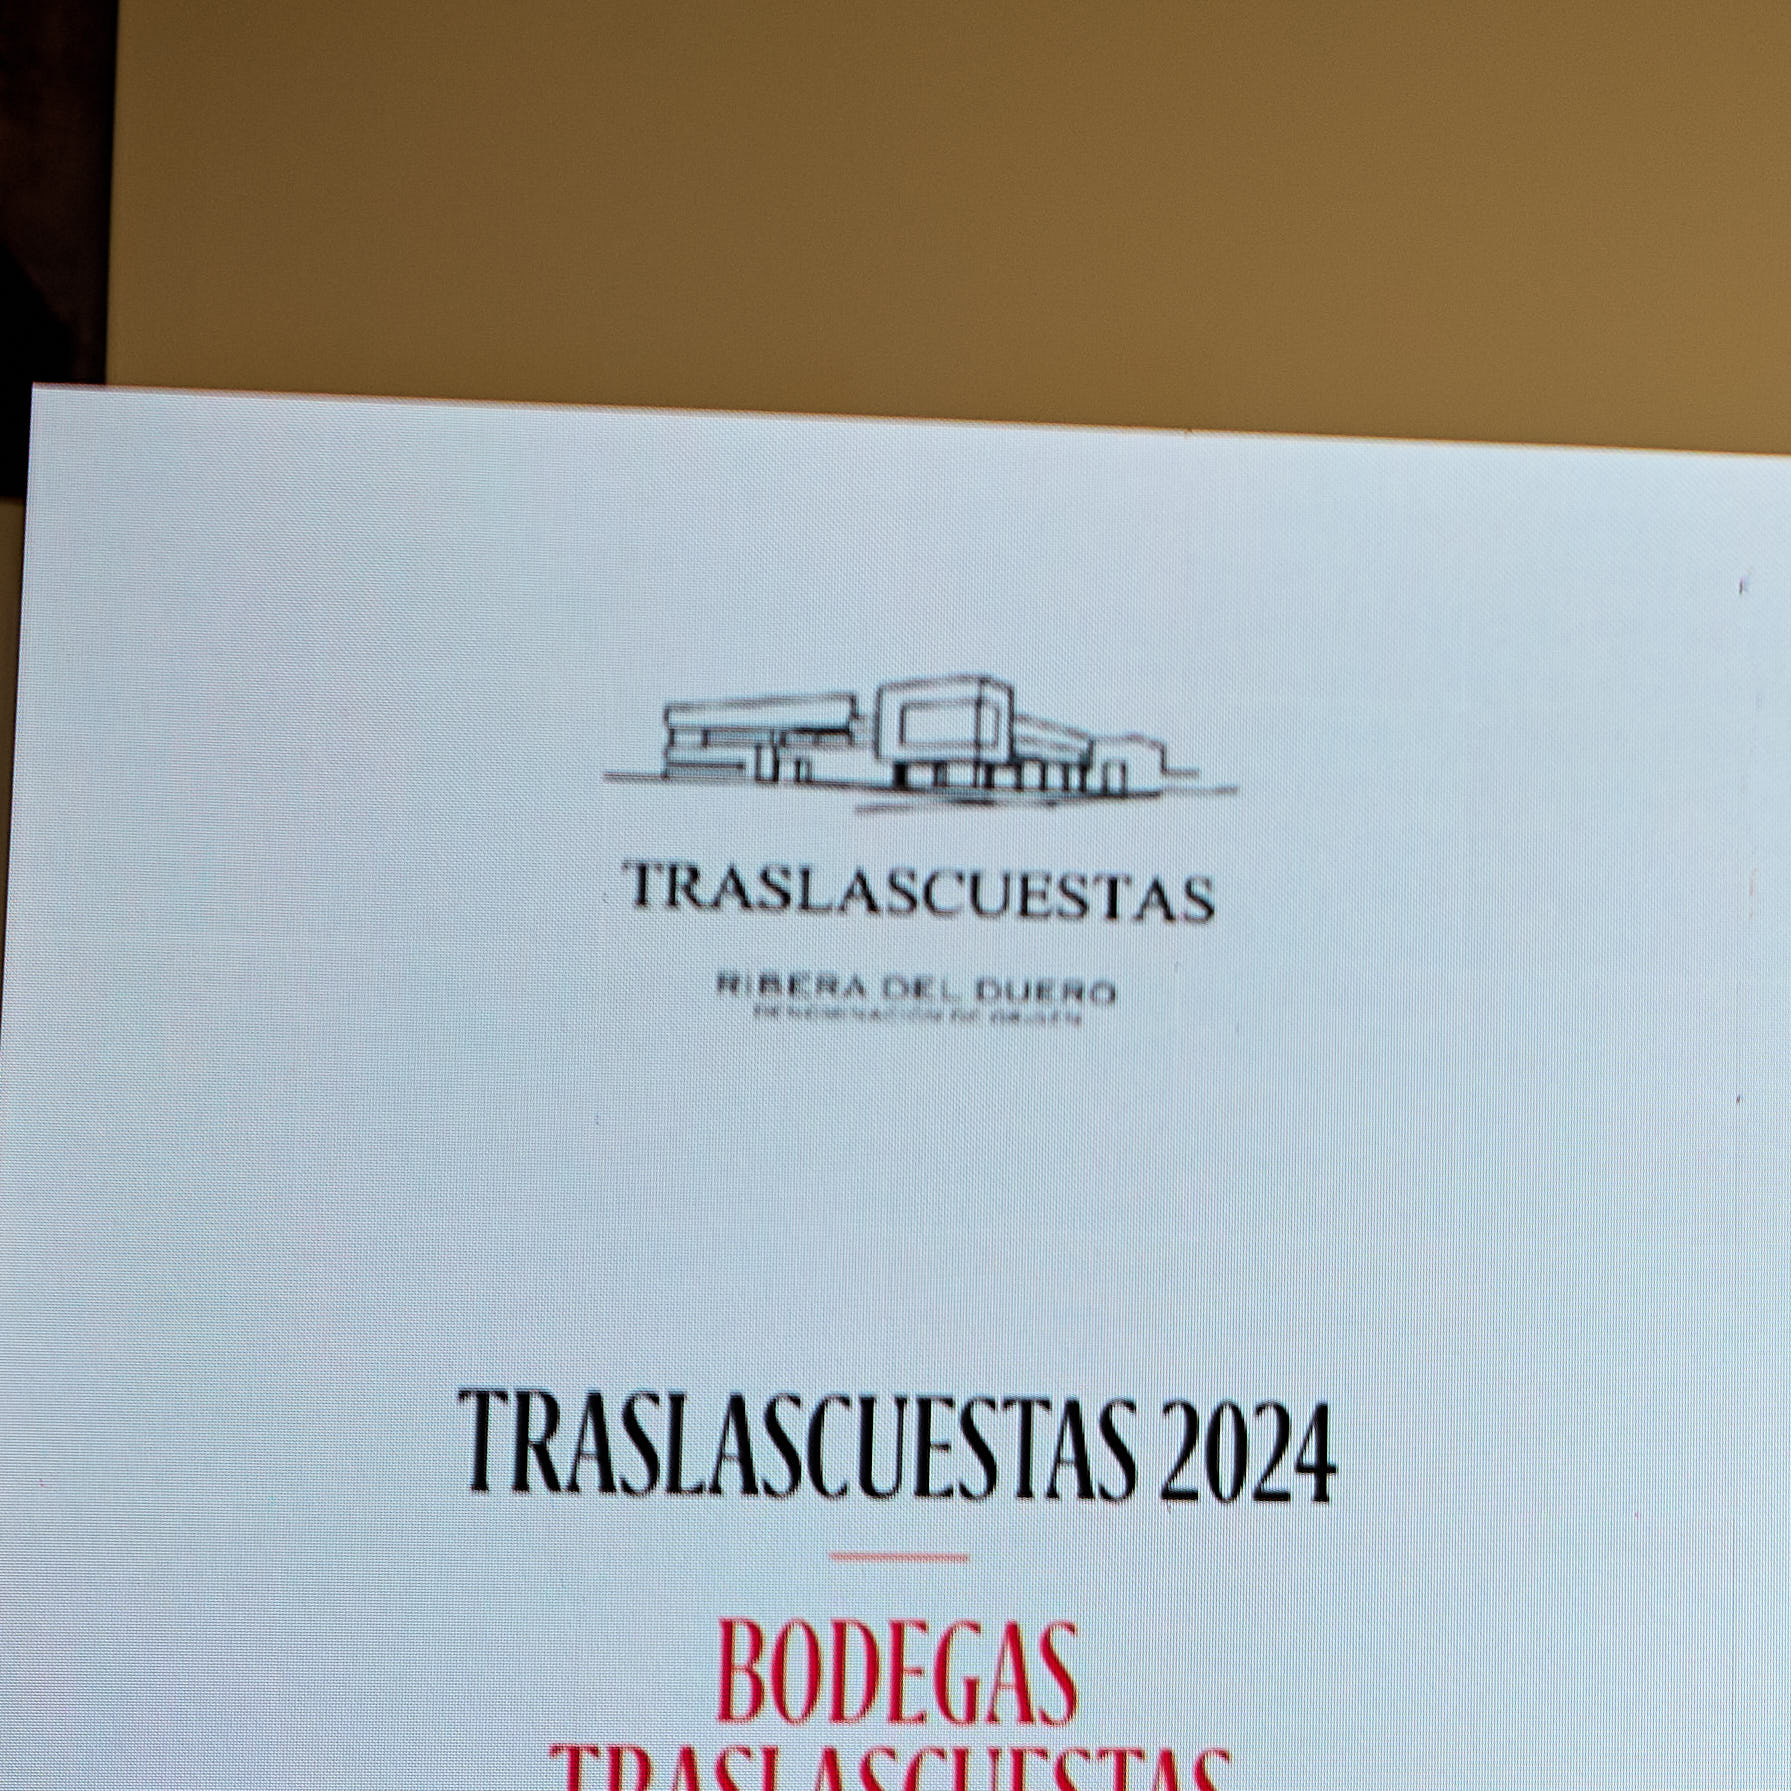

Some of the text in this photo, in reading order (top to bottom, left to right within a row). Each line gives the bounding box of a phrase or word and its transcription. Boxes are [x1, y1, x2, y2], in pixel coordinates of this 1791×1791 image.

[621, 858, 1217, 926] TRASLASCUESTAS
[714, 968, 1120, 1008] RIBERA DEL DUERO
[455, 1386, 1339, 1505] TRASLASCUESTAS 2024
[714, 1615, 1080, 1728] BODEGAS
